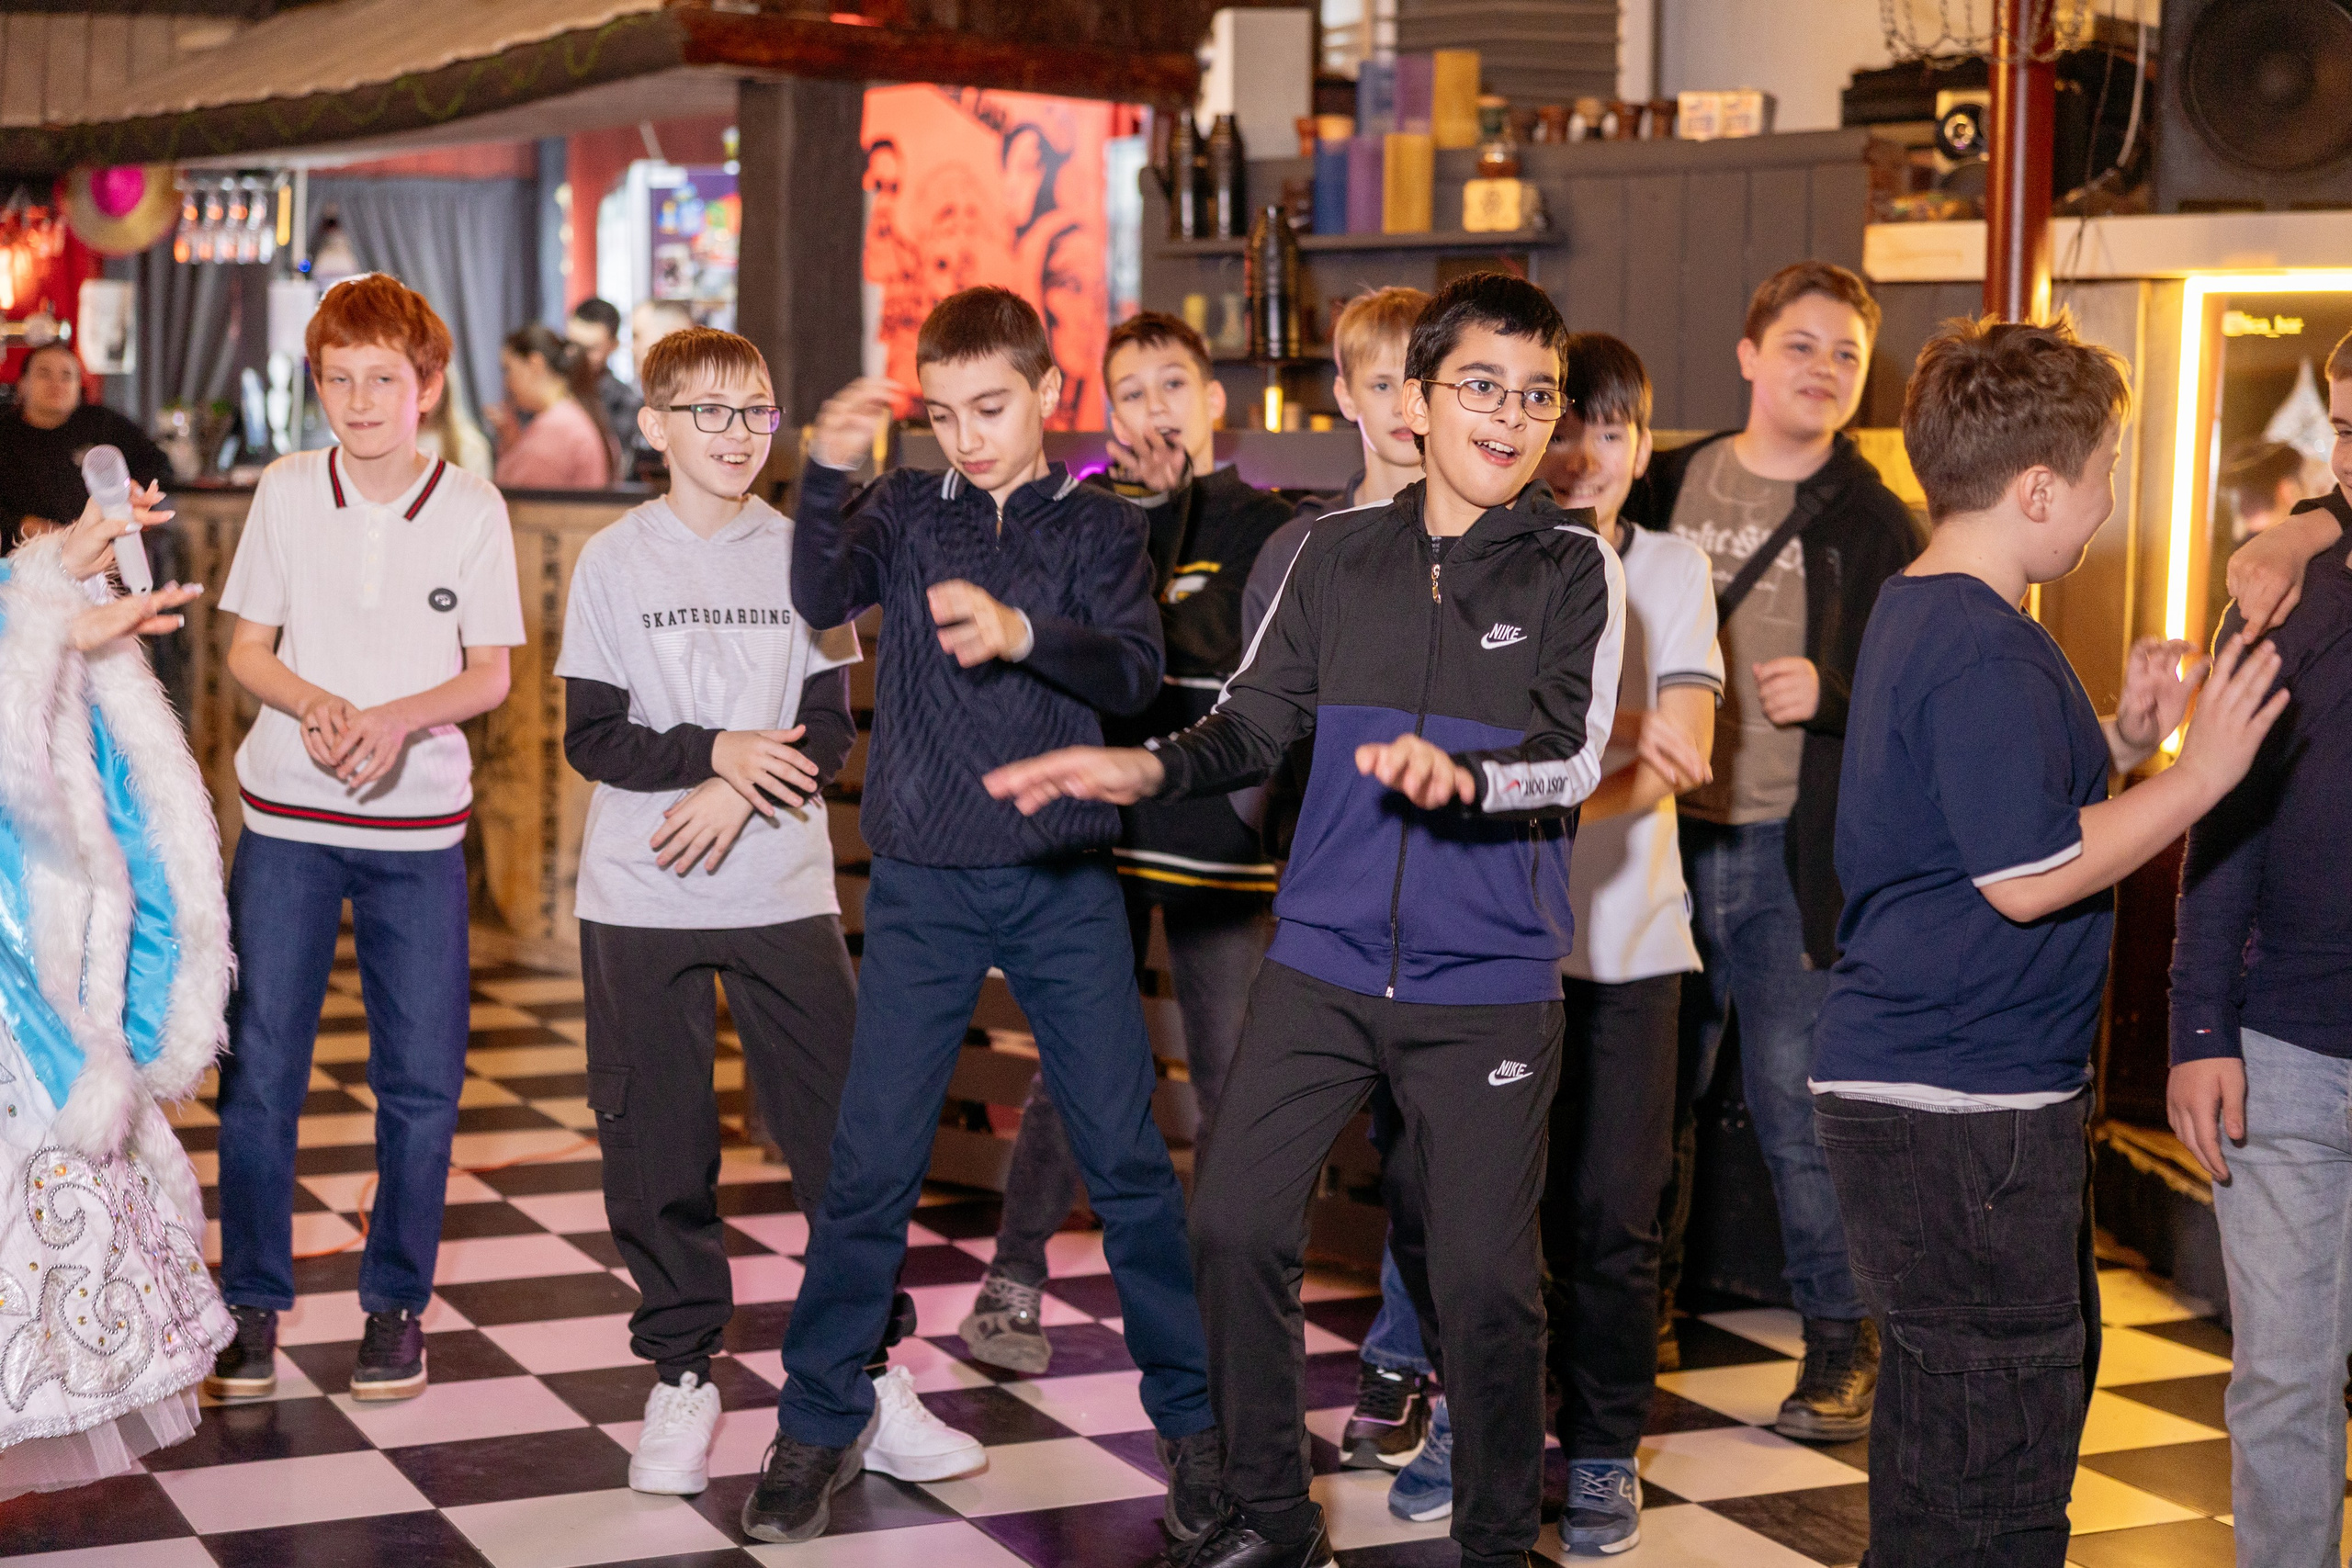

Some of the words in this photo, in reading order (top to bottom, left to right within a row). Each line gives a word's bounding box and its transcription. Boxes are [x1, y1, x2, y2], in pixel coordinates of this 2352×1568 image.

[642, 608, 791, 628] SKATEBOARDING
[1488, 623, 1521, 640] NIKE
[1546, 776, 1568, 795] JUST
[1497, 1059, 1527, 1077] NIKE
